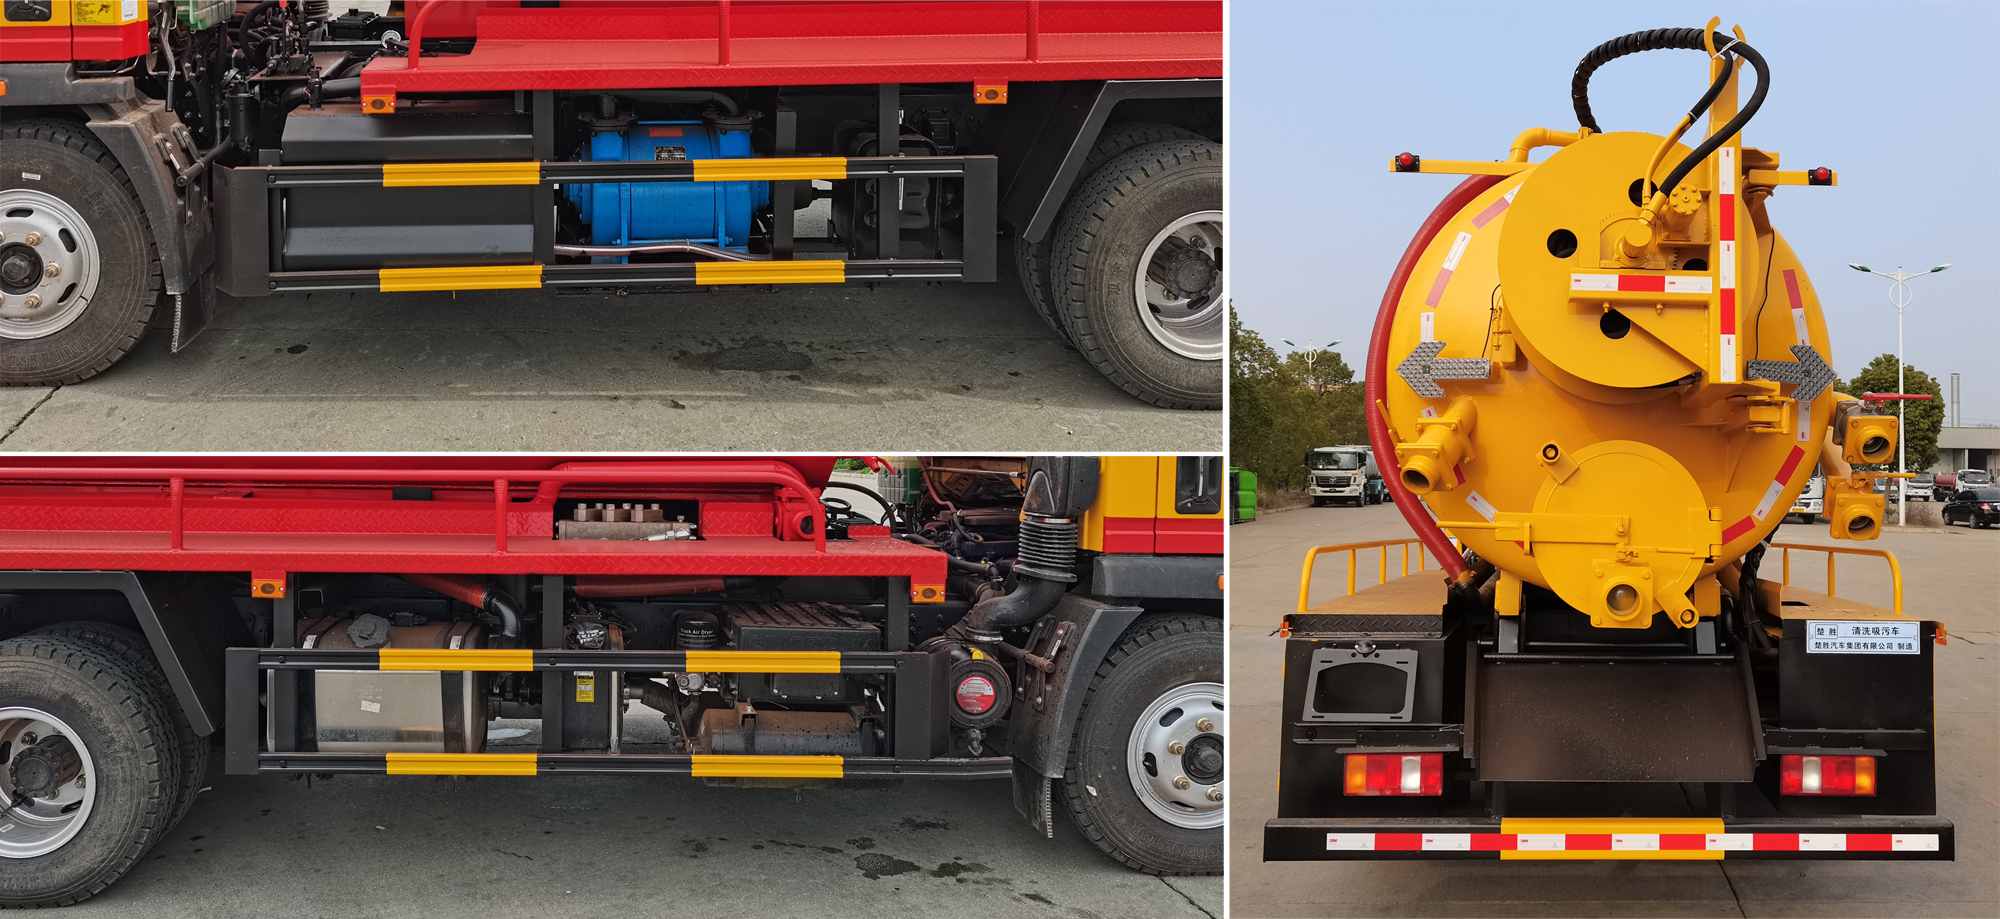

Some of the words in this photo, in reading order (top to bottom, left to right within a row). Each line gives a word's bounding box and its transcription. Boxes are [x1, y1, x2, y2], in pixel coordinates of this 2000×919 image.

[1852, 626, 1900, 635] 清洗吸污车
[1815, 642, 1893, 650] 楚胜汽车集团有限公司
[1897, 642, 1913, 650] 制造
